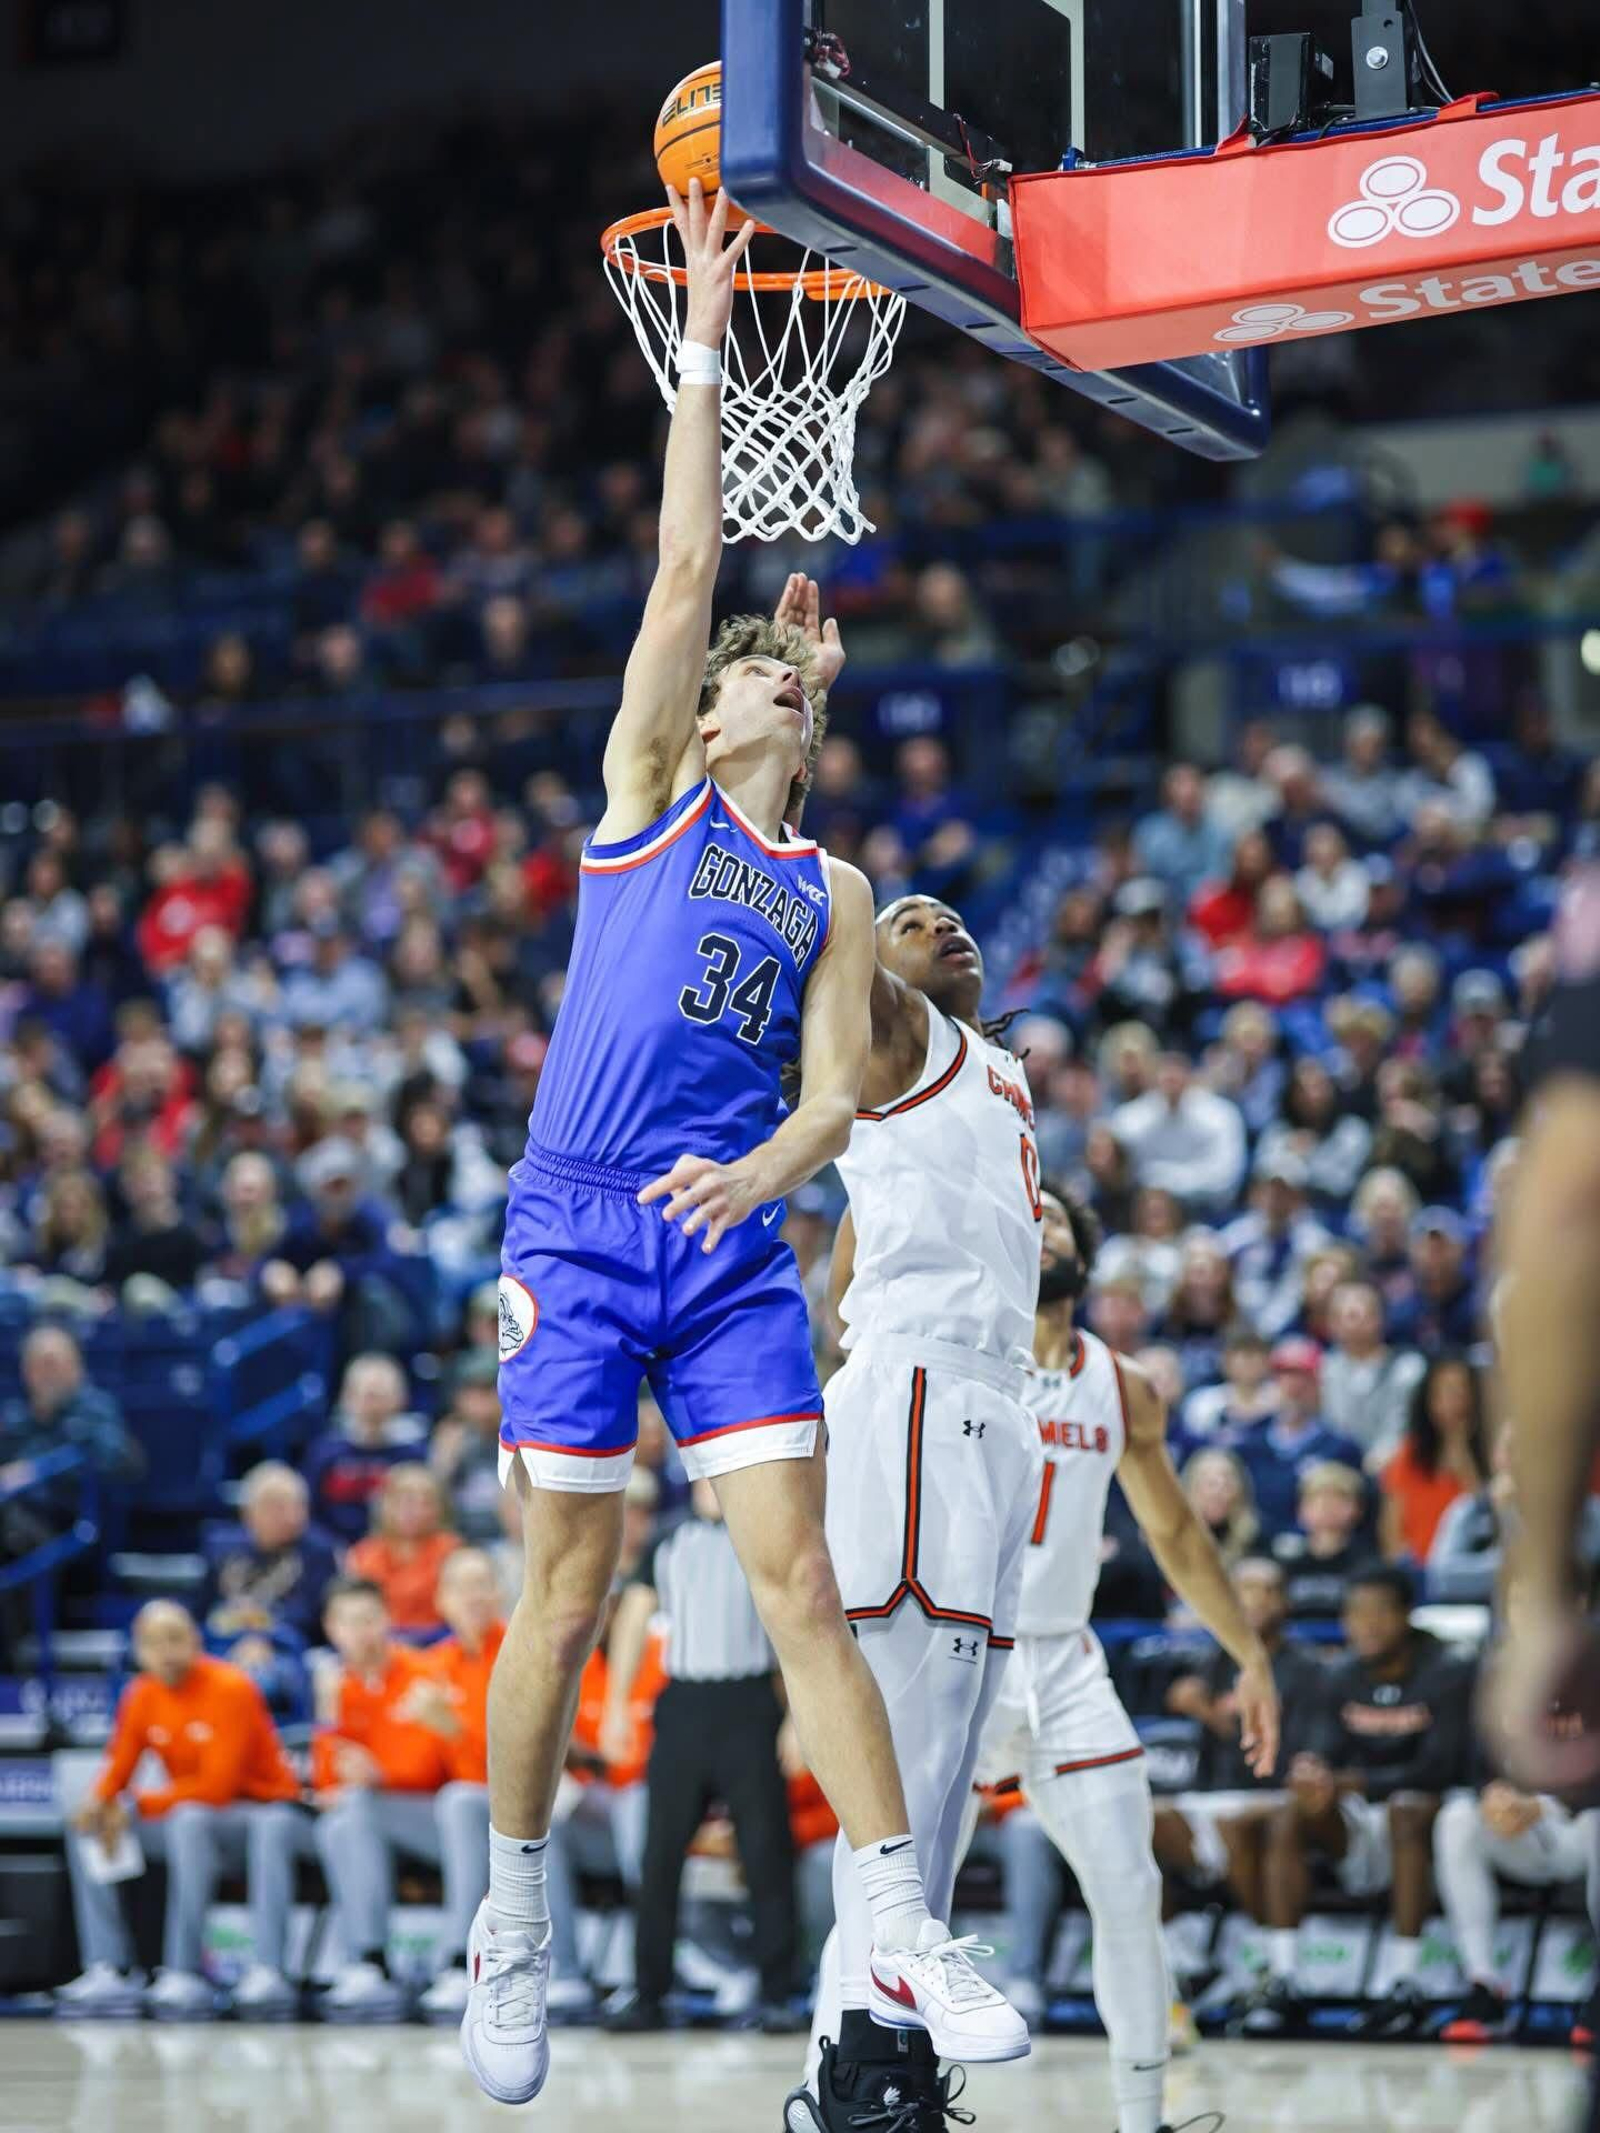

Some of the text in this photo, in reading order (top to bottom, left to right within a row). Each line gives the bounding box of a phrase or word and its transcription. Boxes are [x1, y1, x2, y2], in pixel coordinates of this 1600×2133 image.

[661, 82, 722, 127] ELITE
[1359, 260, 1600, 318] State
[689, 843, 819, 972] GONZAGA
[678, 932, 781, 1046] 34
[1031, 1459, 1057, 1546] 1
